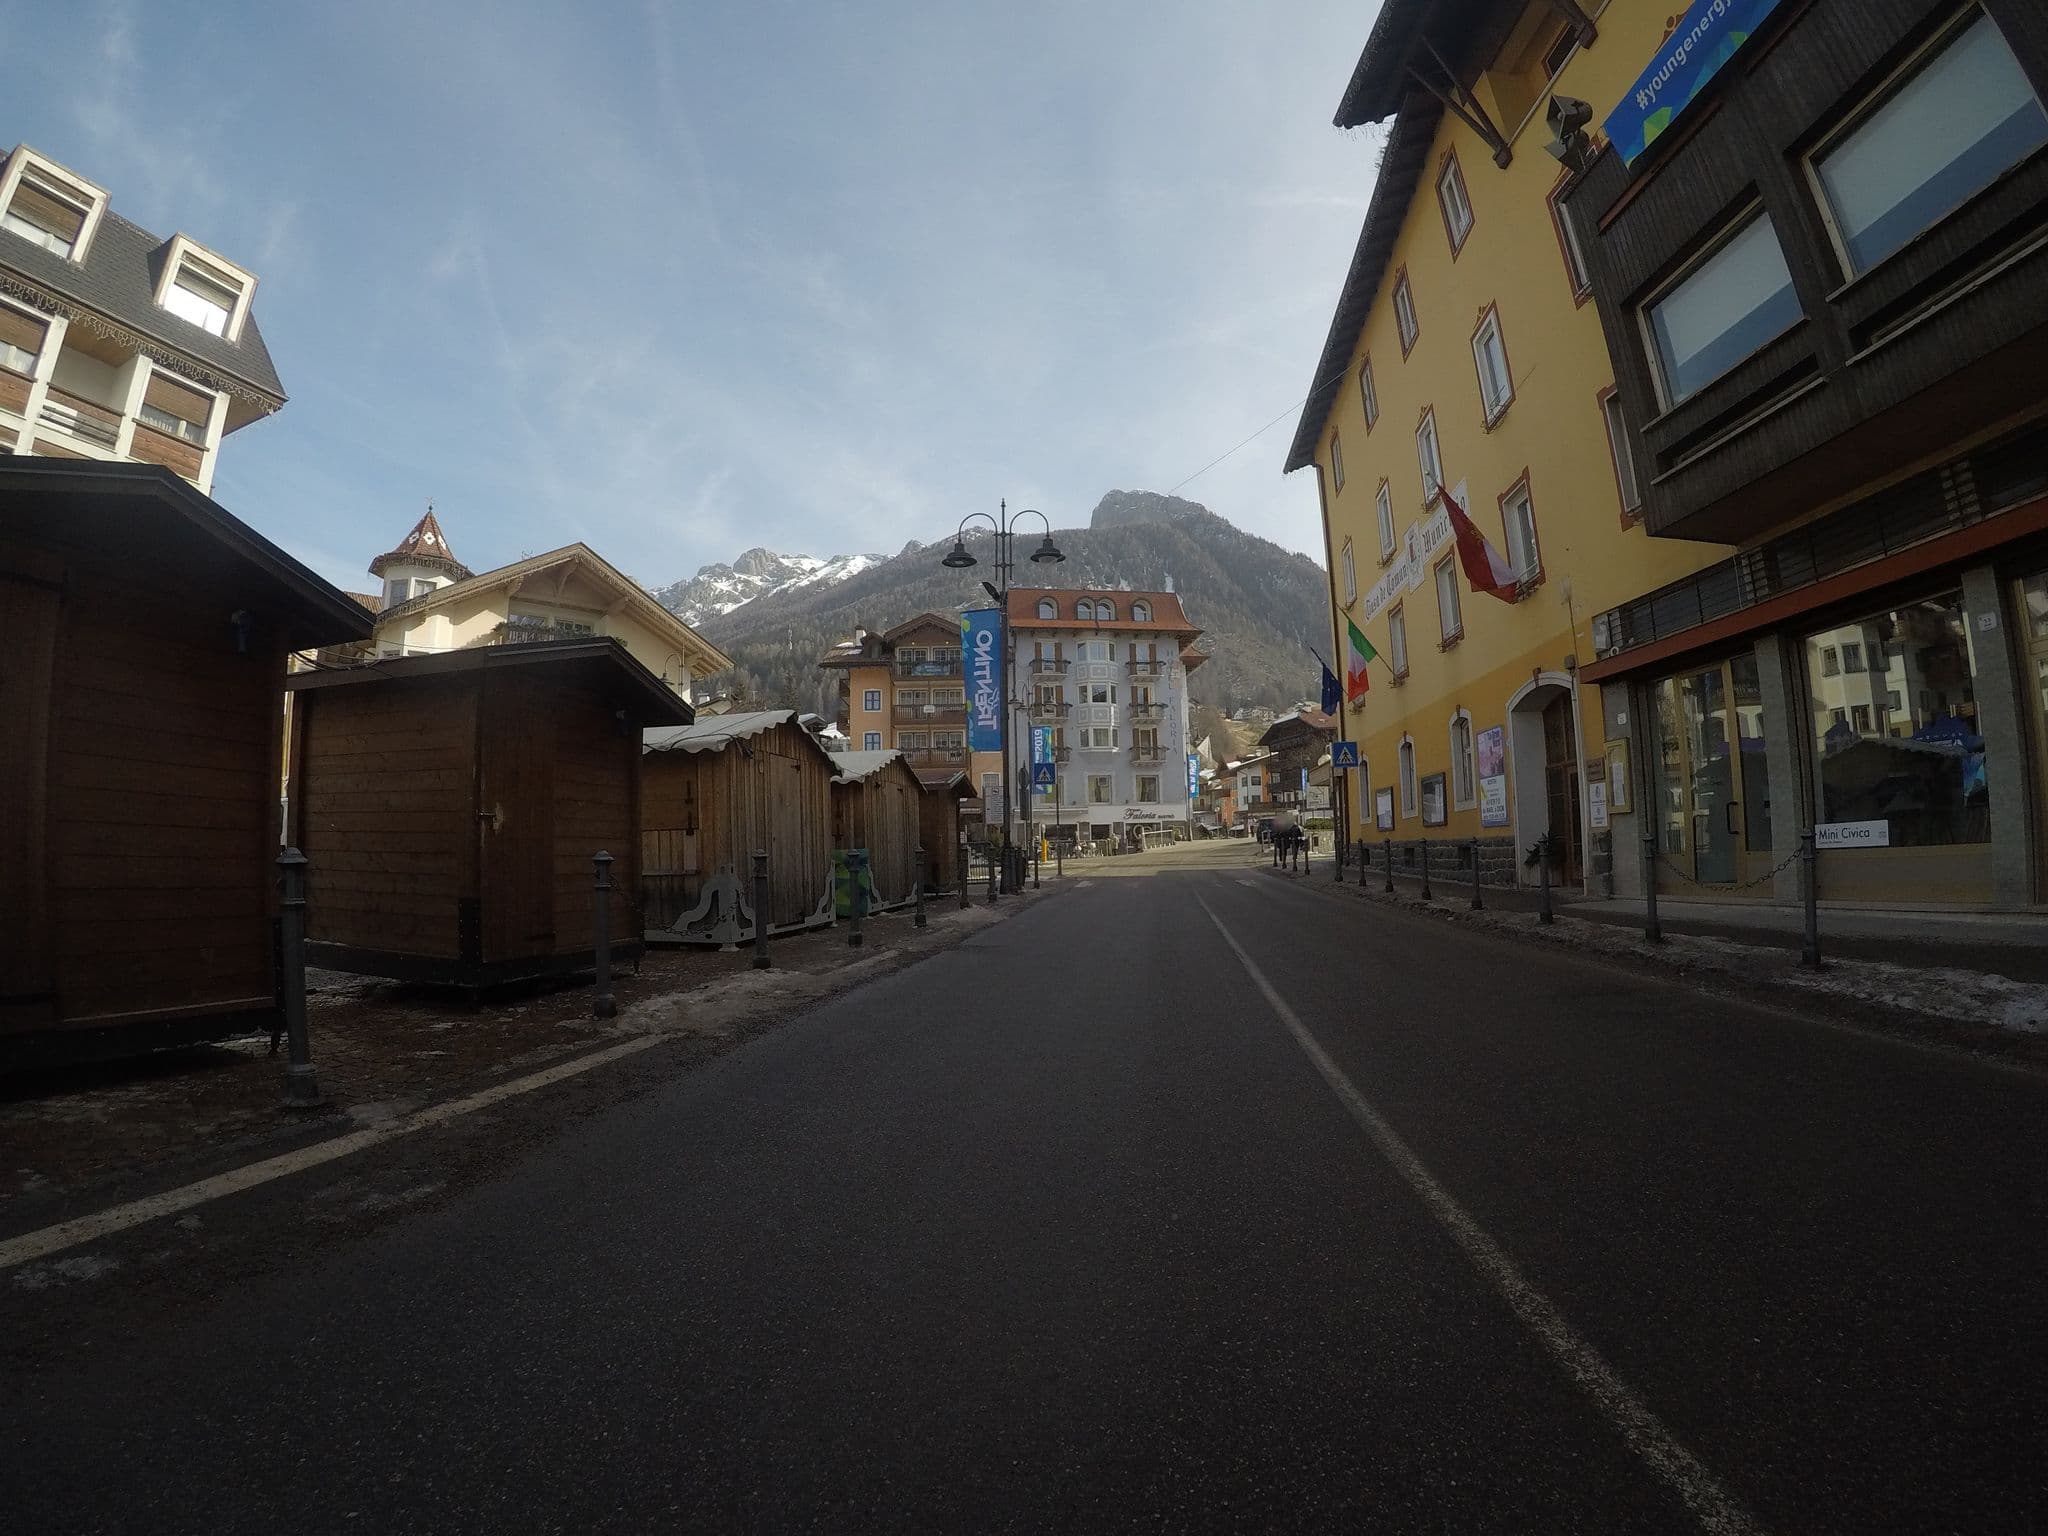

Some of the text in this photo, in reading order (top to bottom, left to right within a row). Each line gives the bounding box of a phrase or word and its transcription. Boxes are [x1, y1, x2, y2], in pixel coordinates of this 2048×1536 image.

[1034, 729, 1043, 752] 2019
[1818, 828, 1838, 840] Mini
[1841, 827, 1870, 839] Civica
